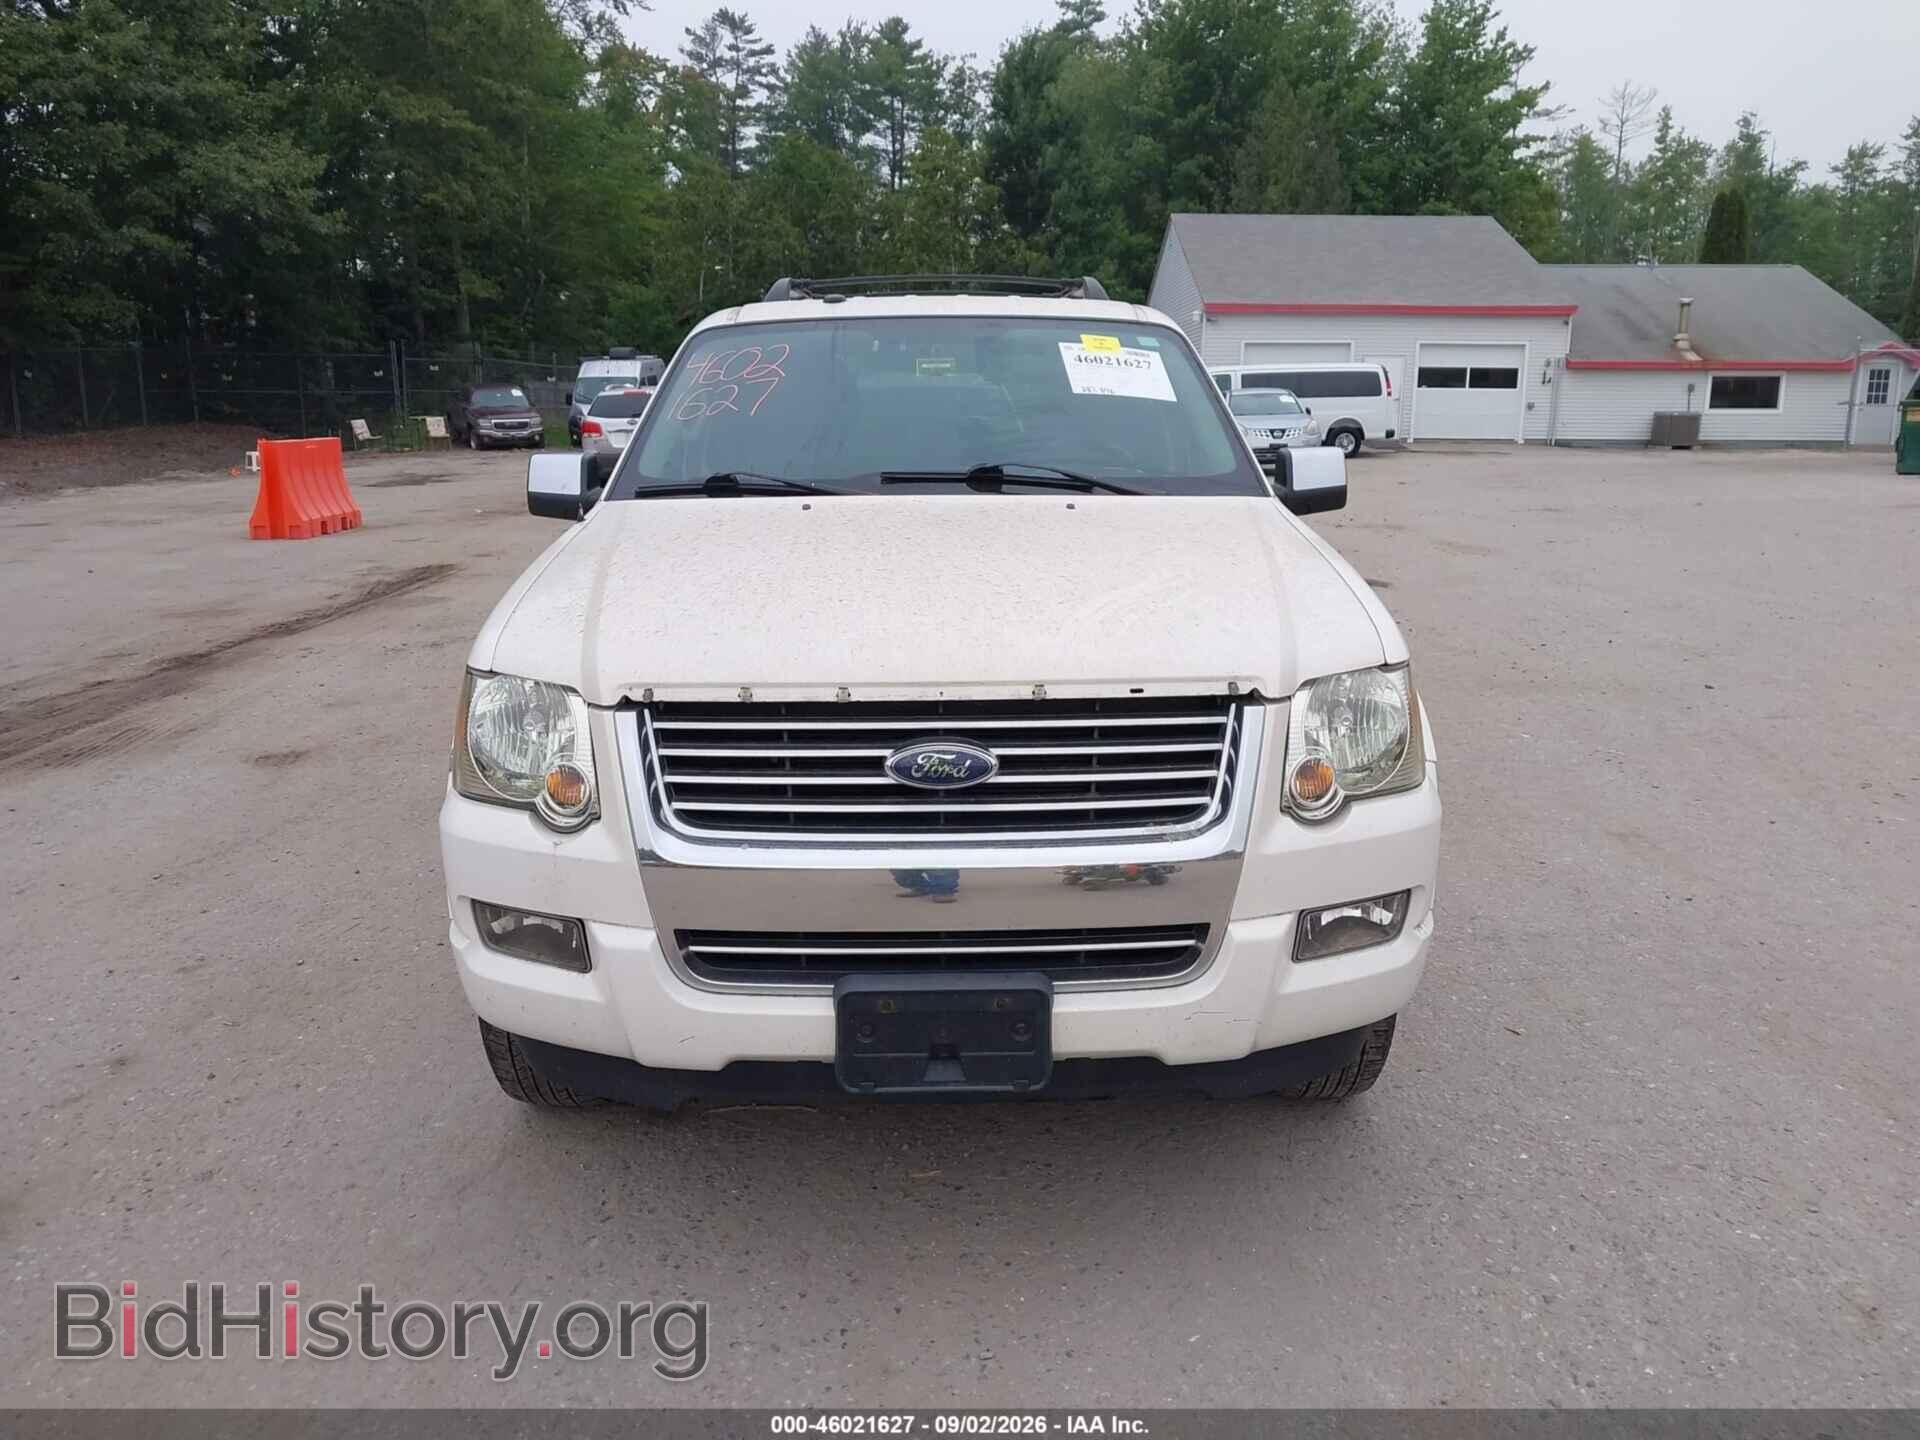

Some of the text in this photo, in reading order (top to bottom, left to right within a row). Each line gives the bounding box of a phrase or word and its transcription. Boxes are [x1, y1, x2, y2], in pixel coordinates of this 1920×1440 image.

[686, 343, 790, 386] 4602
[1073, 353, 1152, 370] 46021627
[667, 376, 779, 421] 1627
[911, 752, 972, 778] Ford
